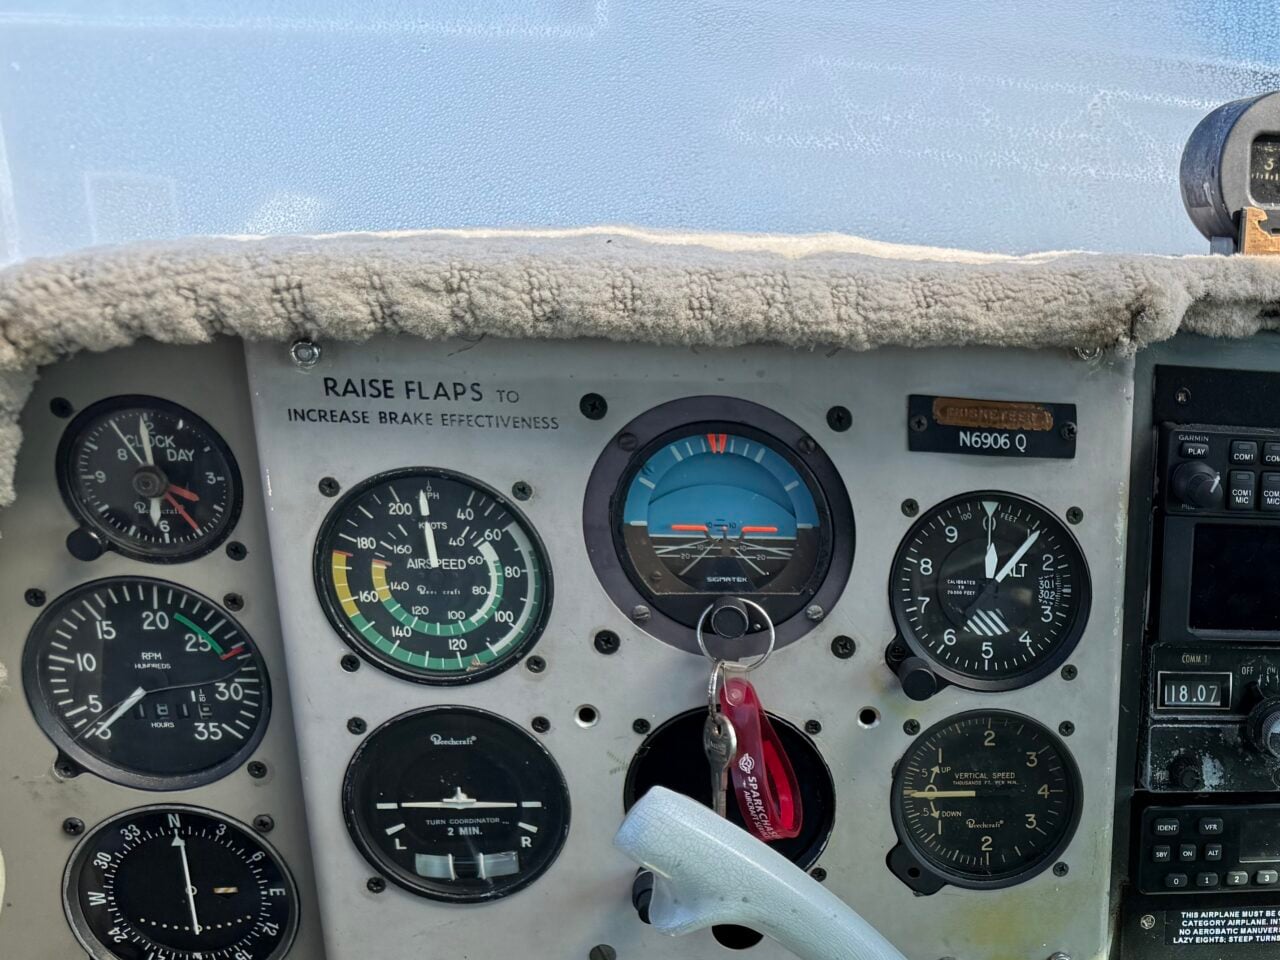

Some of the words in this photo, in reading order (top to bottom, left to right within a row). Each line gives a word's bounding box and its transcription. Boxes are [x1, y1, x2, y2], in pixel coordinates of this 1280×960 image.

[323, 377, 394, 399] RAISE
[404, 380, 483, 401] FLAPS
[496, 390, 519, 403] TO
[288, 408, 370, 424] INCREASE
[378, 411, 433, 426] BRAKE
[441, 414, 559, 430] EFFECTIVENESS
[959, 431, 1010, 449] N6906
[1015, 434, 1027, 452] Q
[1178, 434, 1209, 442] GARMIN
[167, 449, 195, 461] DAY
[388, 502, 412, 515] 200
[357, 537, 376, 550] 180
[358, 590, 379, 603] 160
[142, 612, 169, 630] 20
[494, 610, 513, 623] 100
[96, 621, 117, 639] 15
[391, 625, 411, 638] 140
[448, 638, 467, 651] 120
[77, 654, 96, 672] 10
[141, 652, 162, 661] RPM
[215, 683, 243, 701] 30
[1165, 684, 1218, 703] 118.07
[194, 723, 223, 740] 35
[168, 813, 181, 828] N
[450, 817, 500, 825] COORDINATOR
[395, 839, 407, 849] L
[521, 837, 532, 847] R
[87, 891, 107, 906] W
